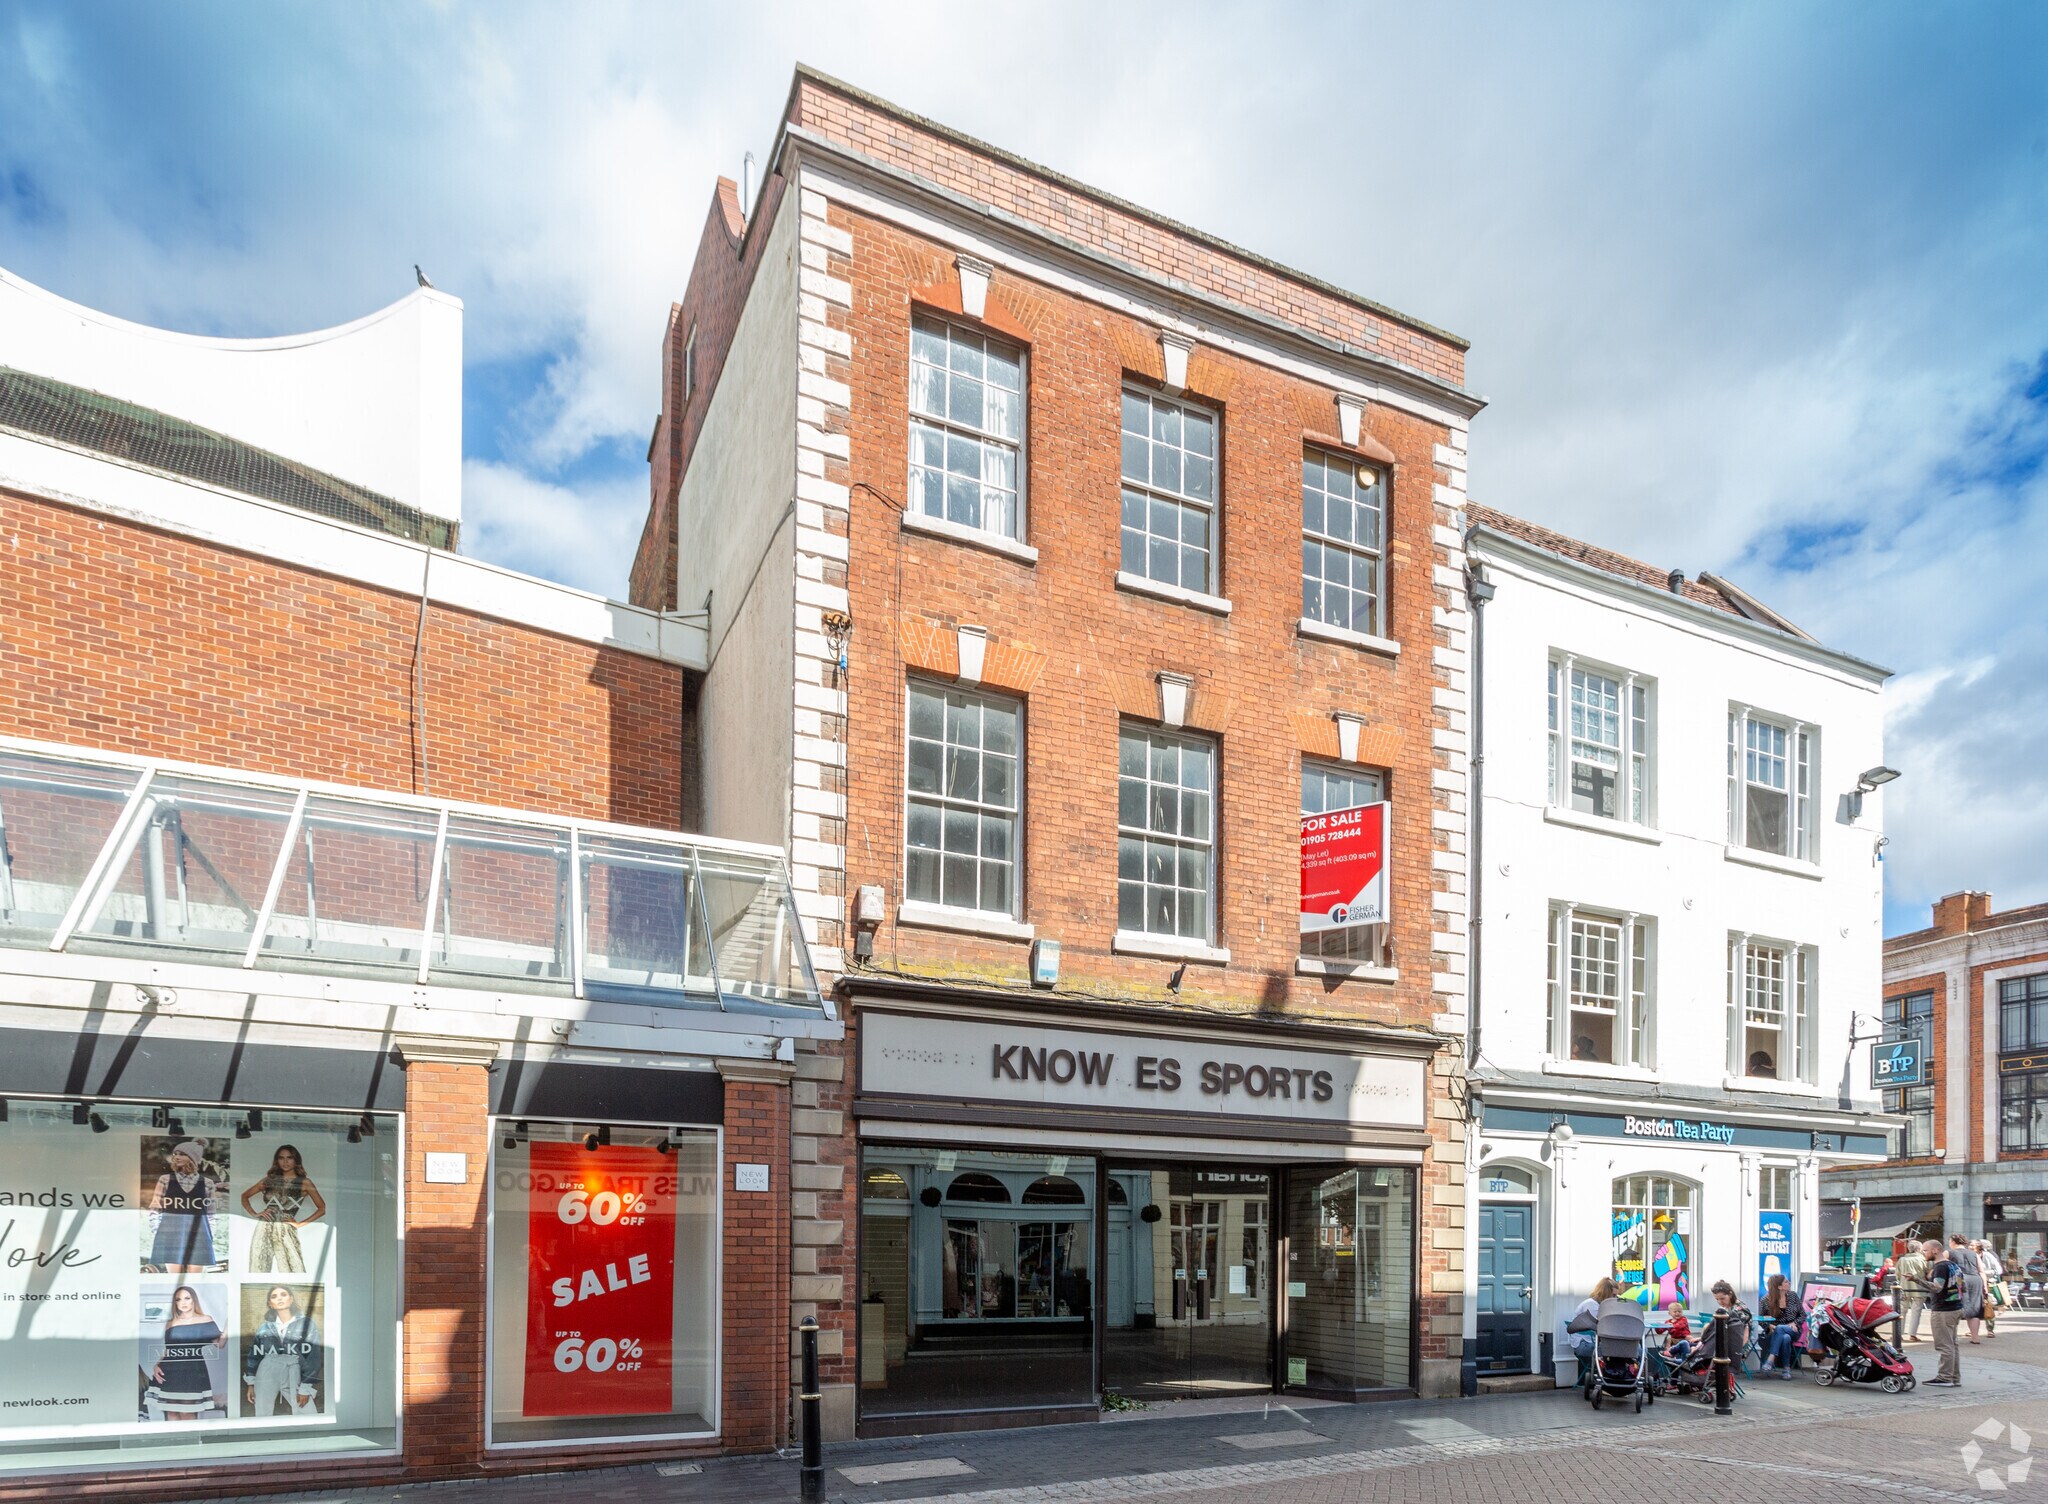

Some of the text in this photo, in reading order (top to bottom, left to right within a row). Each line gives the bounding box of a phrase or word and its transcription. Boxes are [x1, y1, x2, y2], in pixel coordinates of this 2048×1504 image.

[1301, 811, 1362, 833] FOR SALE
[1301, 828, 1361, 846] 01905 728444
[1349, 904, 1375, 913] FISHER
[1349, 910, 1381, 921] GERMAN
[993, 1044, 1334, 1101] KNOW ES SPORTS
[1878, 1056, 1914, 1075] BTP
[1625, 1115, 1734, 1146] Boston Tea Party
[1490, 1181, 1508, 1192] BTP
[0, 1187, 125, 1208] ands we
[149, 1196, 222, 1210] APRICOT
[265, 1195, 304, 1210] AX
[558, 1191, 647, 1226] 60%
[620, 1216, 645, 1226] OFF
[552, 1253, 651, 1307] SALE
[4, 1291, 121, 1301] in store and online
[553, 1338, 643, 1373] 60%
[616, 1362, 641, 1371] OFF
[3, 1397, 89, 1407] newlook.com
